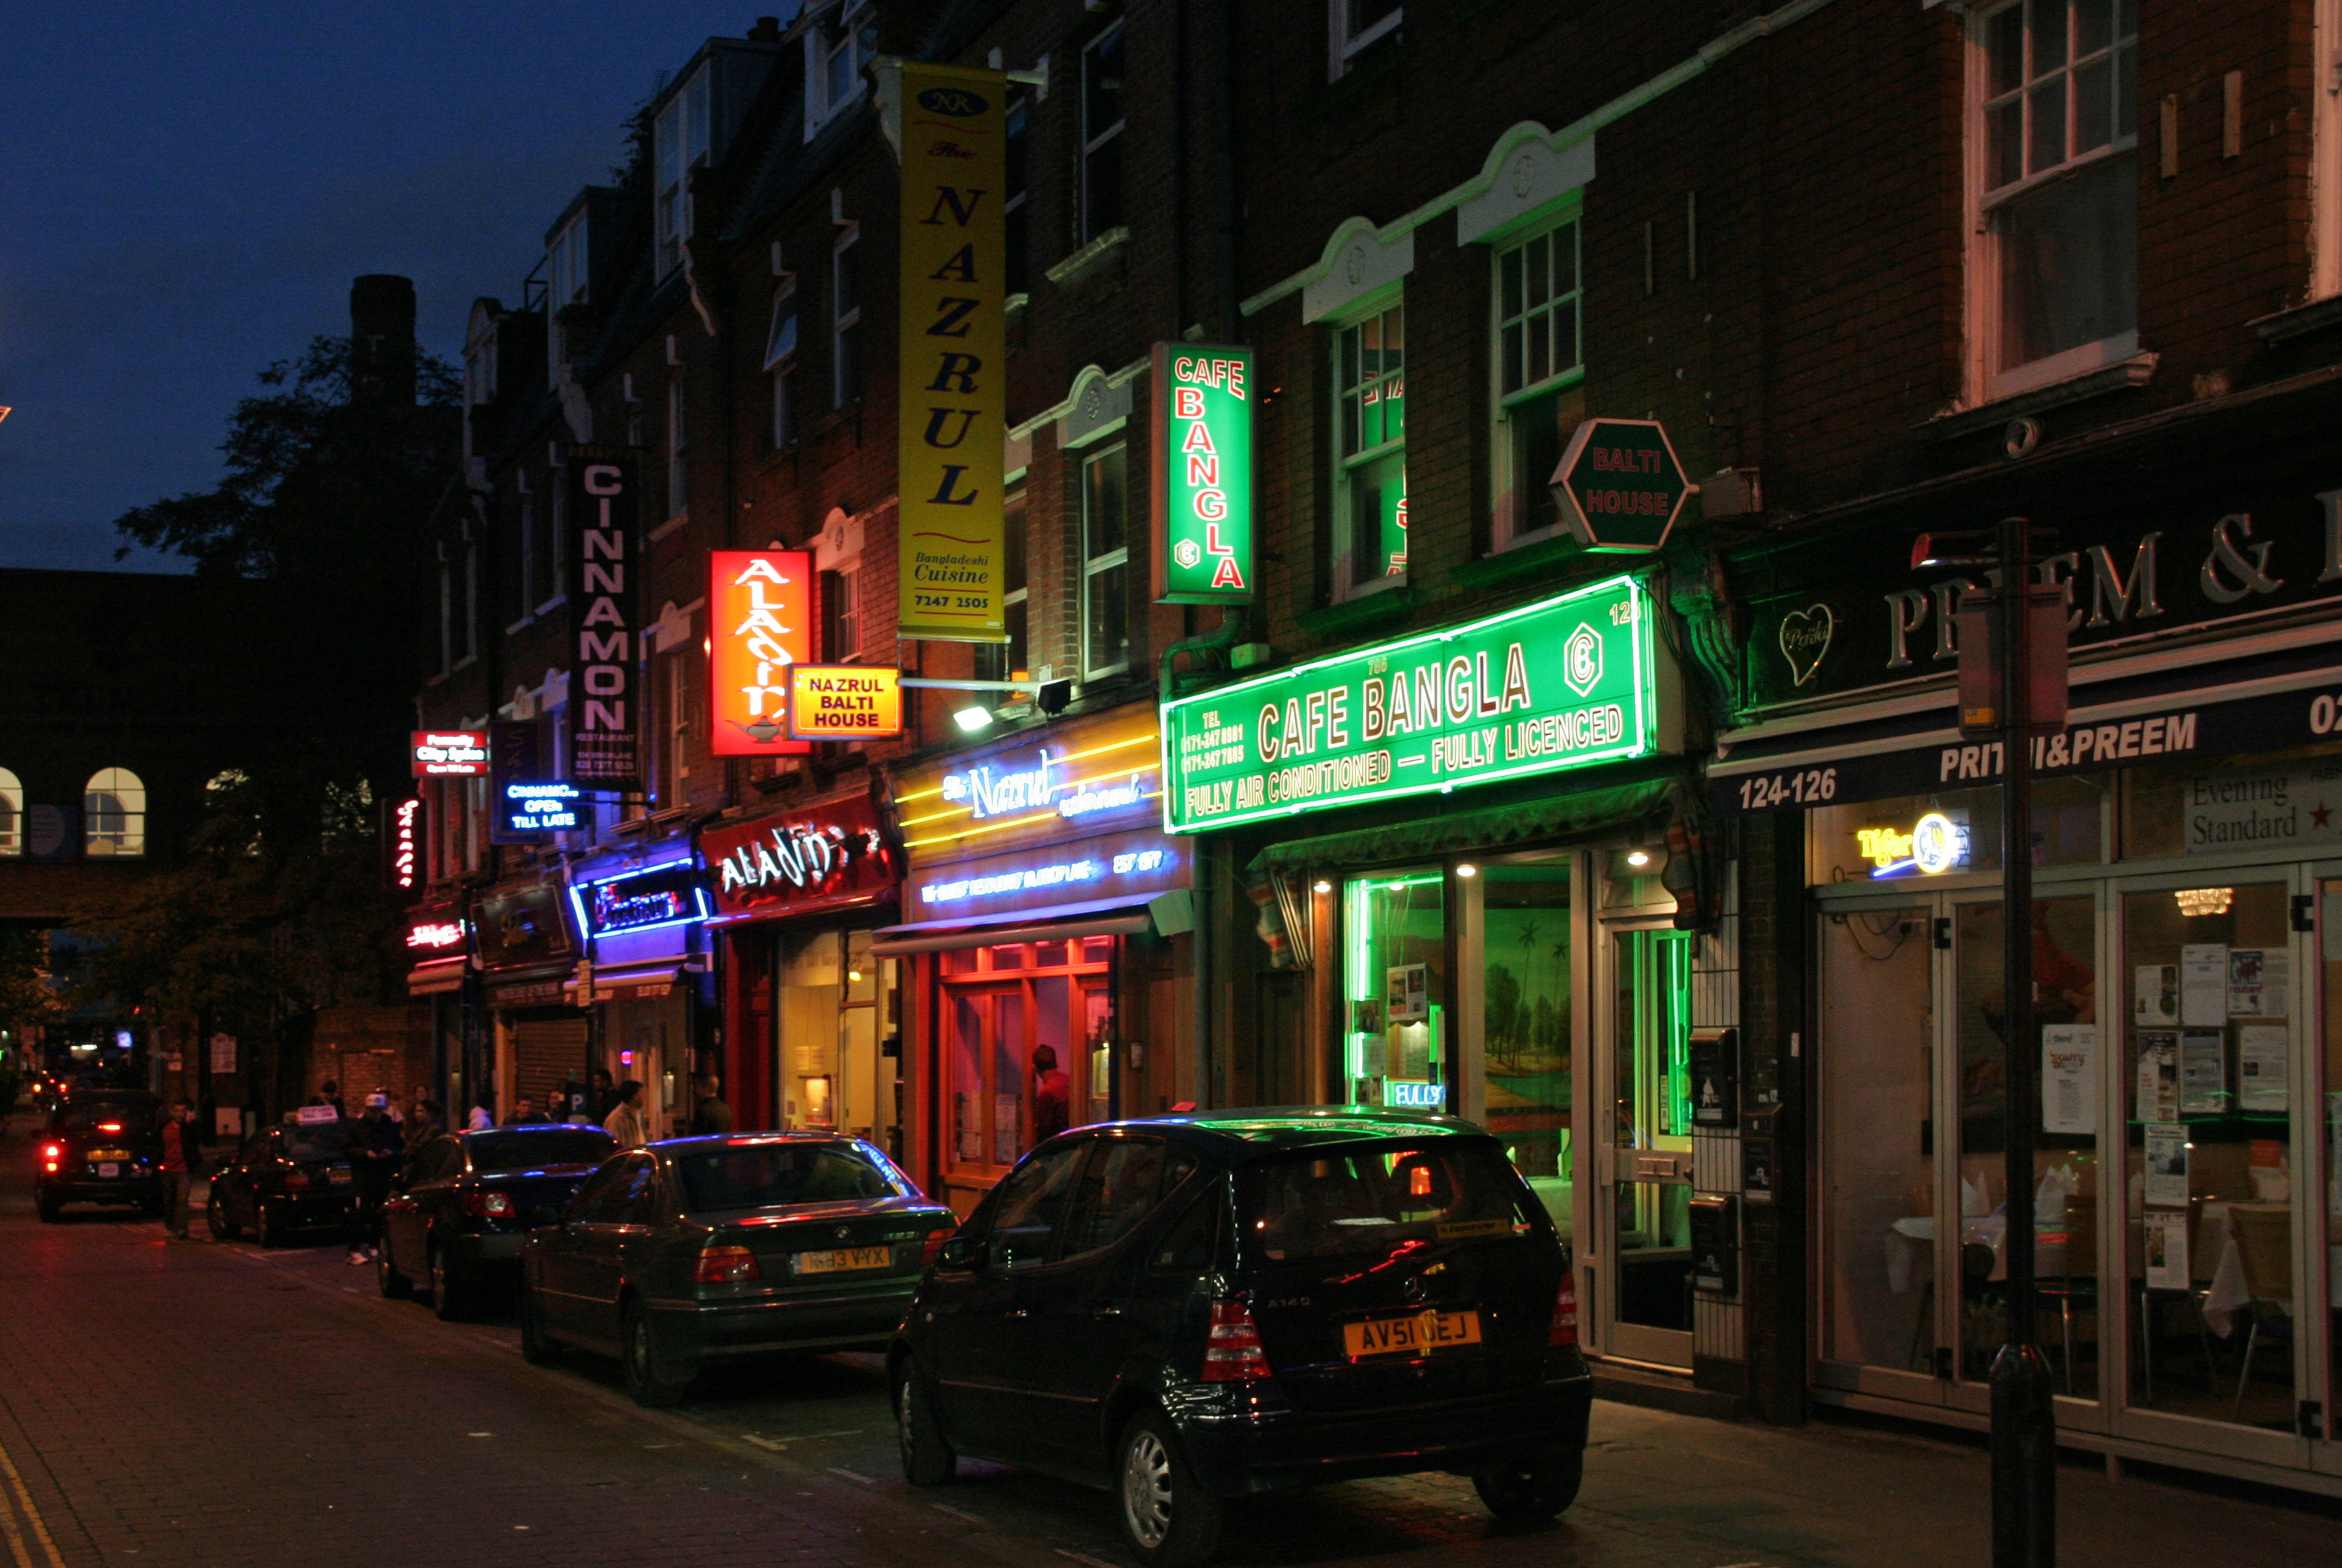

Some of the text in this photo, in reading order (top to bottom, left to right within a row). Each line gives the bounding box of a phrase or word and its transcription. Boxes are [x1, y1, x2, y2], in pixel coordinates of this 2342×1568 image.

[920, 185, 987, 505] NAZRUL
[1174, 356, 1245, 401] CAFE
[1594, 447, 1661, 473] BALTI
[1174, 386, 1245, 589] BANGLA
[1586, 489, 1669, 515] HOUSE
[915, 552, 989, 566] Bangladeshi
[914, 564, 989, 584] Cuisine
[580, 464, 629, 730] CINNAMON
[915, 596, 989, 608] 7247 2505
[809, 678, 884, 693] NAZRUL
[821, 696, 873, 710] BALTI
[1257, 642, 1531, 763] CAFE BANGLA
[815, 713, 879, 727] HOUSE
[1202, 710, 1221, 729] TEL
[576, 733, 635, 742] RESTAURANT
[1186, 704, 1623, 818] FULLY AIR CONDITIONED FULLY LICENCED
[1739, 768, 1837, 809] 124-126
[2193, 777, 2288, 807] Evening
[512, 813, 575, 829] TILL LATE
[2193, 806, 2297, 845] Standard
[1858, 828, 1913, 868] Tiger
[571, 1094, 583, 1111] P
[1362, 1320, 1415, 1349] AV51
